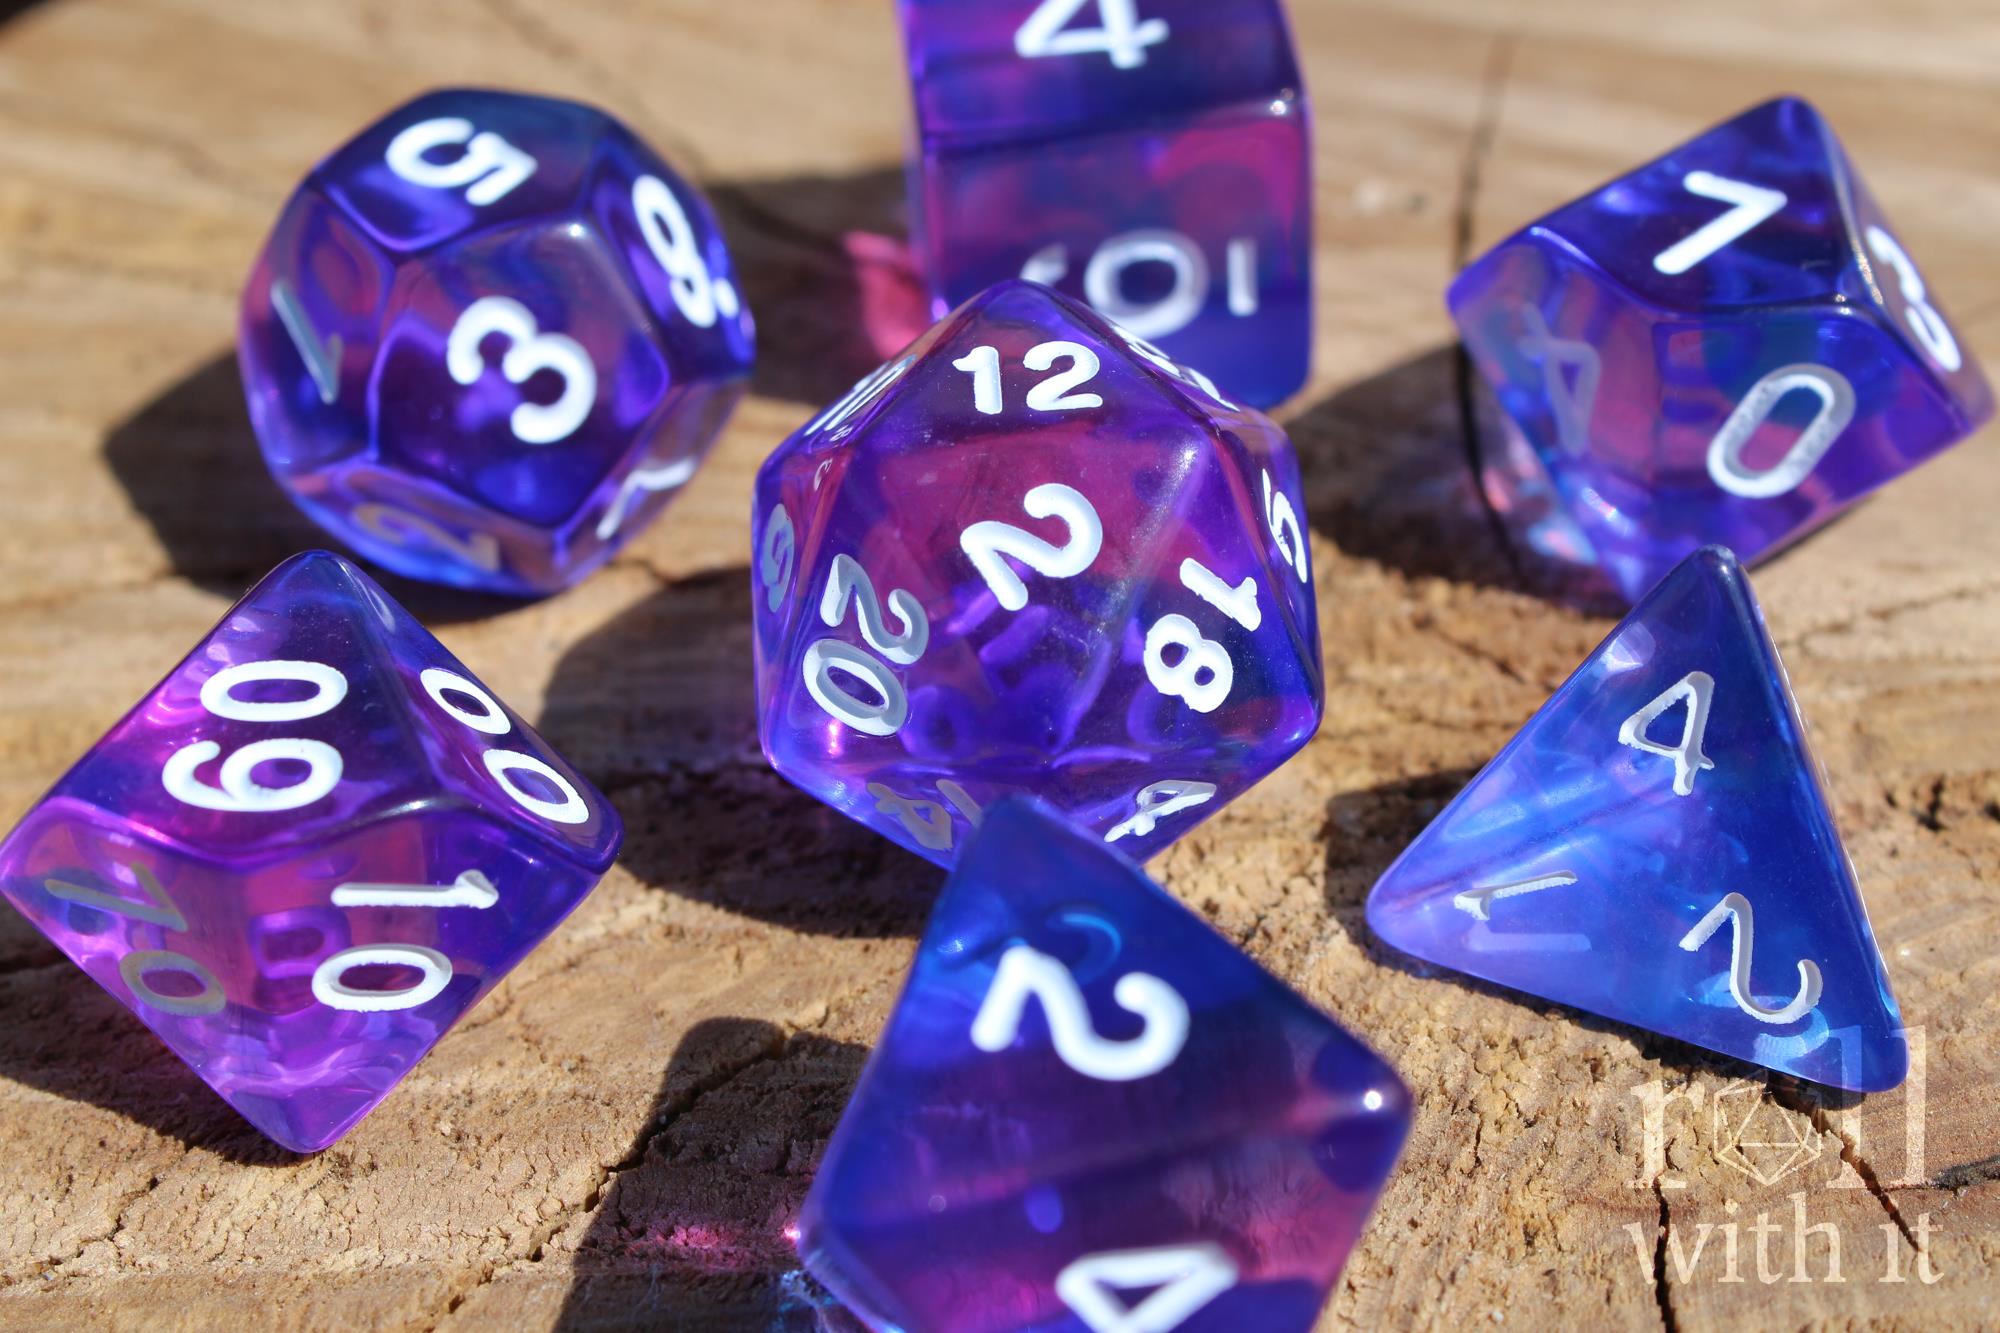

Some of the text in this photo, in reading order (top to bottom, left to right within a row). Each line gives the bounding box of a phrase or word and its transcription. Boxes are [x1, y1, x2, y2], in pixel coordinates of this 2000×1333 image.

[1015, 0, 1169, 68] 4
[386, 117, 537, 205] 5
[1653, 171, 1787, 275] 7
[447, 296, 596, 443] 3
[952, 341, 1103, 414] 12
[1707, 363, 1856, 498] 0
[960, 483, 1103, 611] 2
[803, 553, 929, 736] 20
[1143, 557, 1262, 712] 18
[420, 668, 589, 823] 00
[1618, 671, 1714, 796] 4
[1104, 779, 1217, 842] 4
[312, 870, 498, 1012] 10
[1679, 893, 1823, 1024] 2
[971, 946, 1190, 1080] 2
